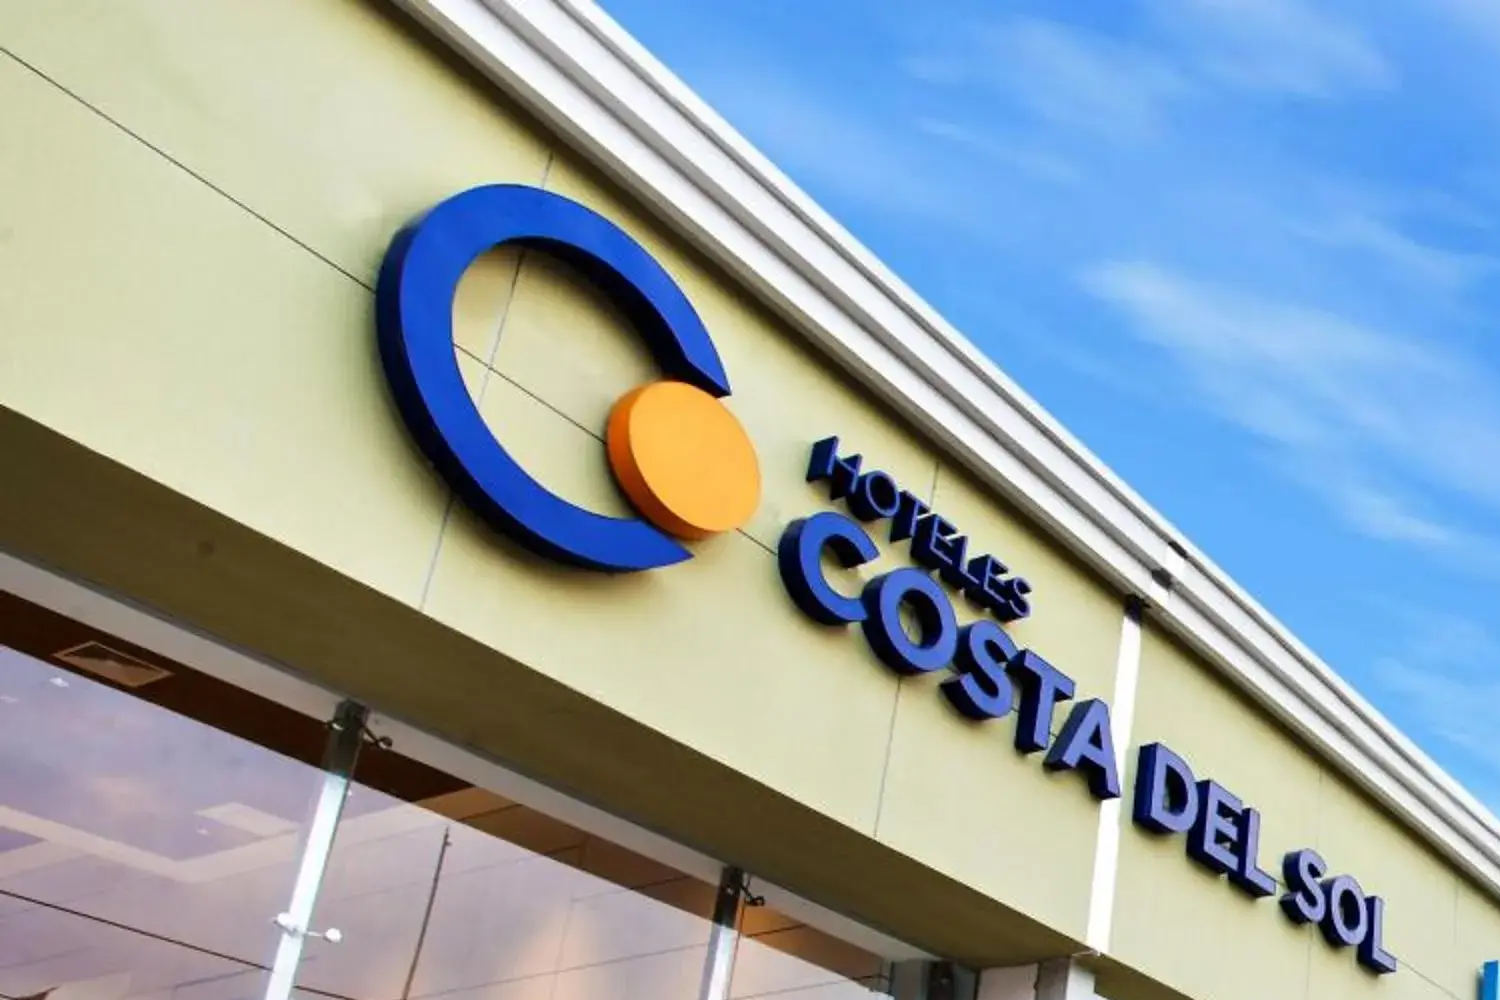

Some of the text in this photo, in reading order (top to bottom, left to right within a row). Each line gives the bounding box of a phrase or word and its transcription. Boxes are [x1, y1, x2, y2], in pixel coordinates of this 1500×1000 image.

[806, 435, 1032, 622] HOTELES
[778, 511, 1397, 974] COSTA DEL SOL
